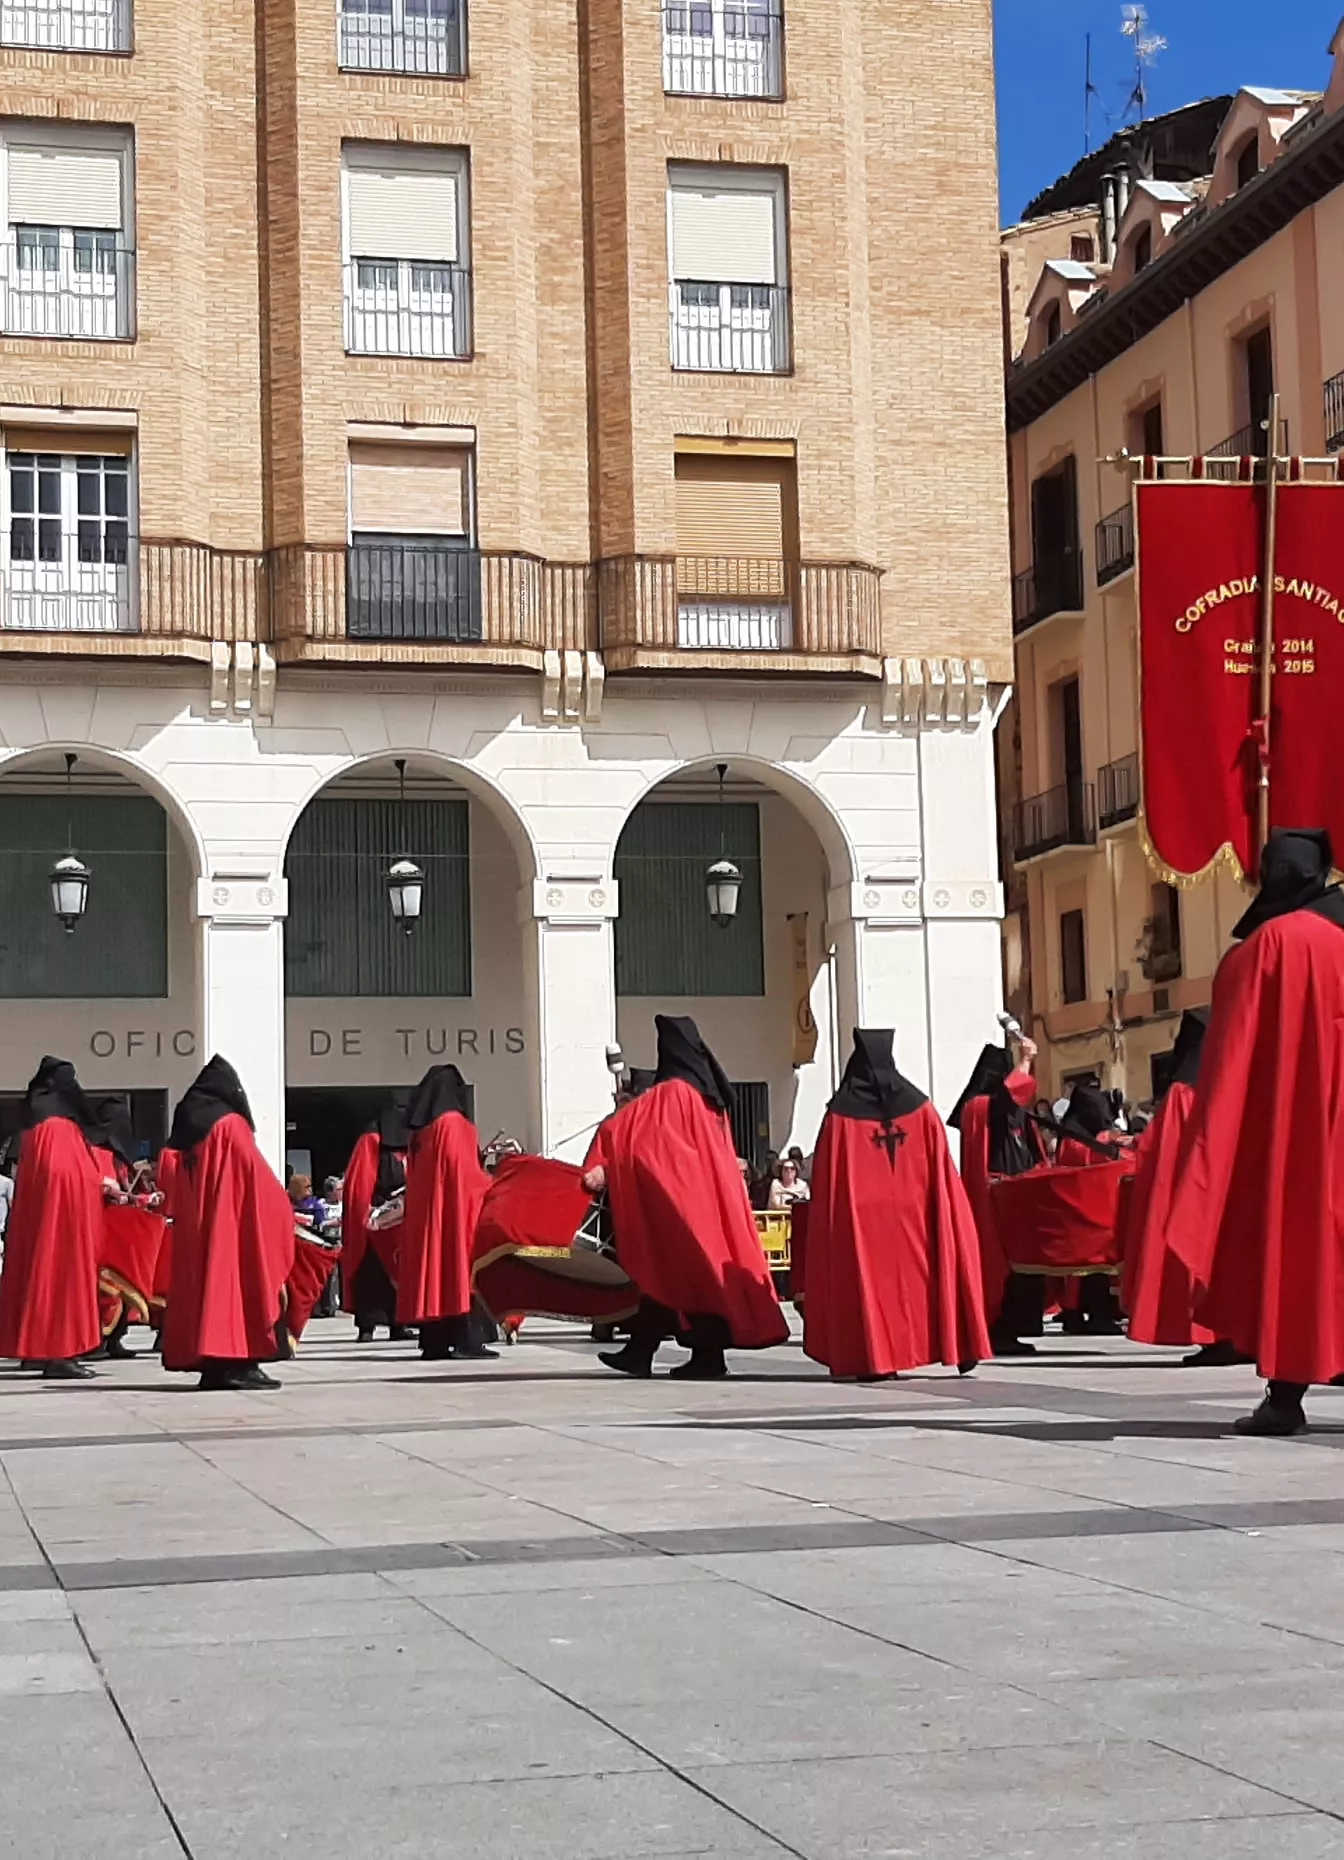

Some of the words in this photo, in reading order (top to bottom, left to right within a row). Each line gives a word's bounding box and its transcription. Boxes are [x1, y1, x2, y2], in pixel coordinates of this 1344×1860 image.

[1282, 638, 1315, 654] 2014
[1283, 659, 1316, 675] 2015
[89, 1030, 197, 1058] OFIC
[309, 1029, 363, 1057] DE
[395, 1027, 526, 1056] TURIS
